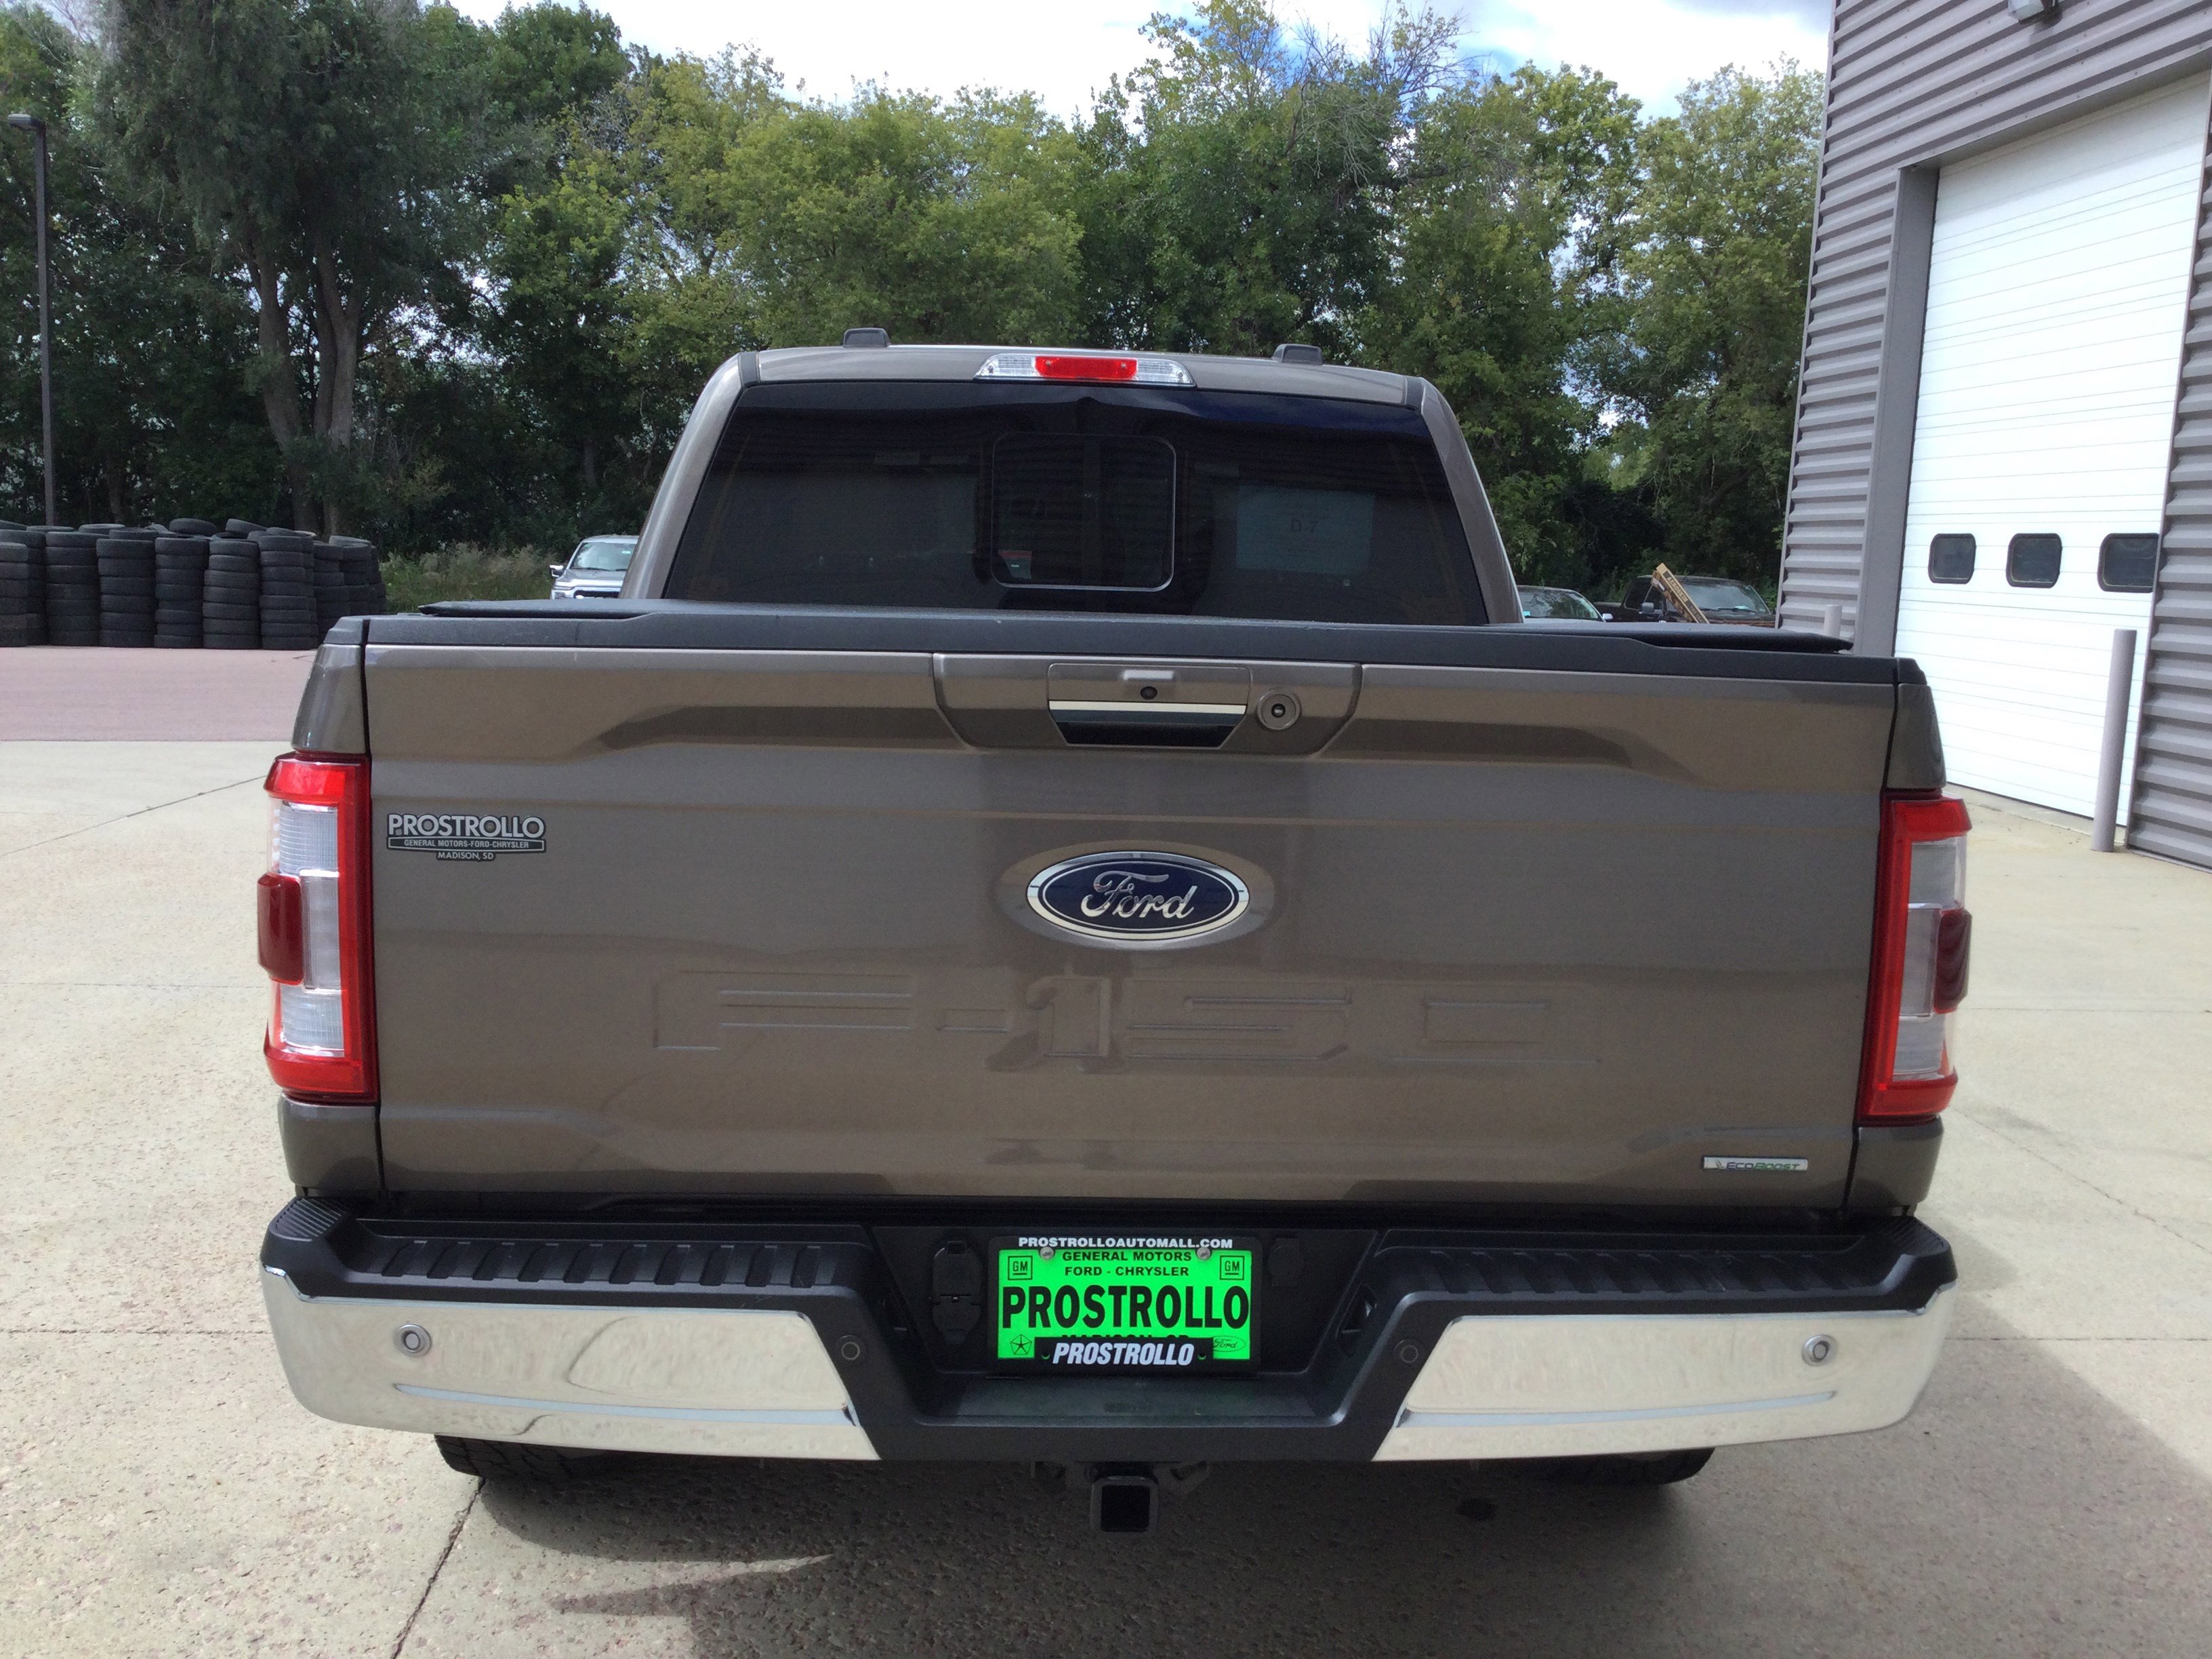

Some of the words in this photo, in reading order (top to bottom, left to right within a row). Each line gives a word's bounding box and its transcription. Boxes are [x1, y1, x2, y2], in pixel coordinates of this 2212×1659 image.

[388, 815, 544, 838] PROSTROLLO
[438, 852, 480, 860] MADISON,
[1080, 870, 1198, 919] Ford
[1019, 1237, 1233, 1249] PROSTROLLOAUTOMALL.COM
[1062, 1251, 1129, 1262] GENERAL
[1133, 1251, 1192, 1262] MOTORS
[1012, 1261, 1028, 1272] GM
[1065, 1266, 1102, 1276] FORD
[1115, 1266, 1189, 1277] CHRYSLER
[1225, 1261, 1240, 1272] GM
[1002, 1284, 1250, 1329] PROSTROLLO
[1213, 1338, 1239, 1349] Ford
[1052, 1343, 1195, 1366] PROSTROLLO
